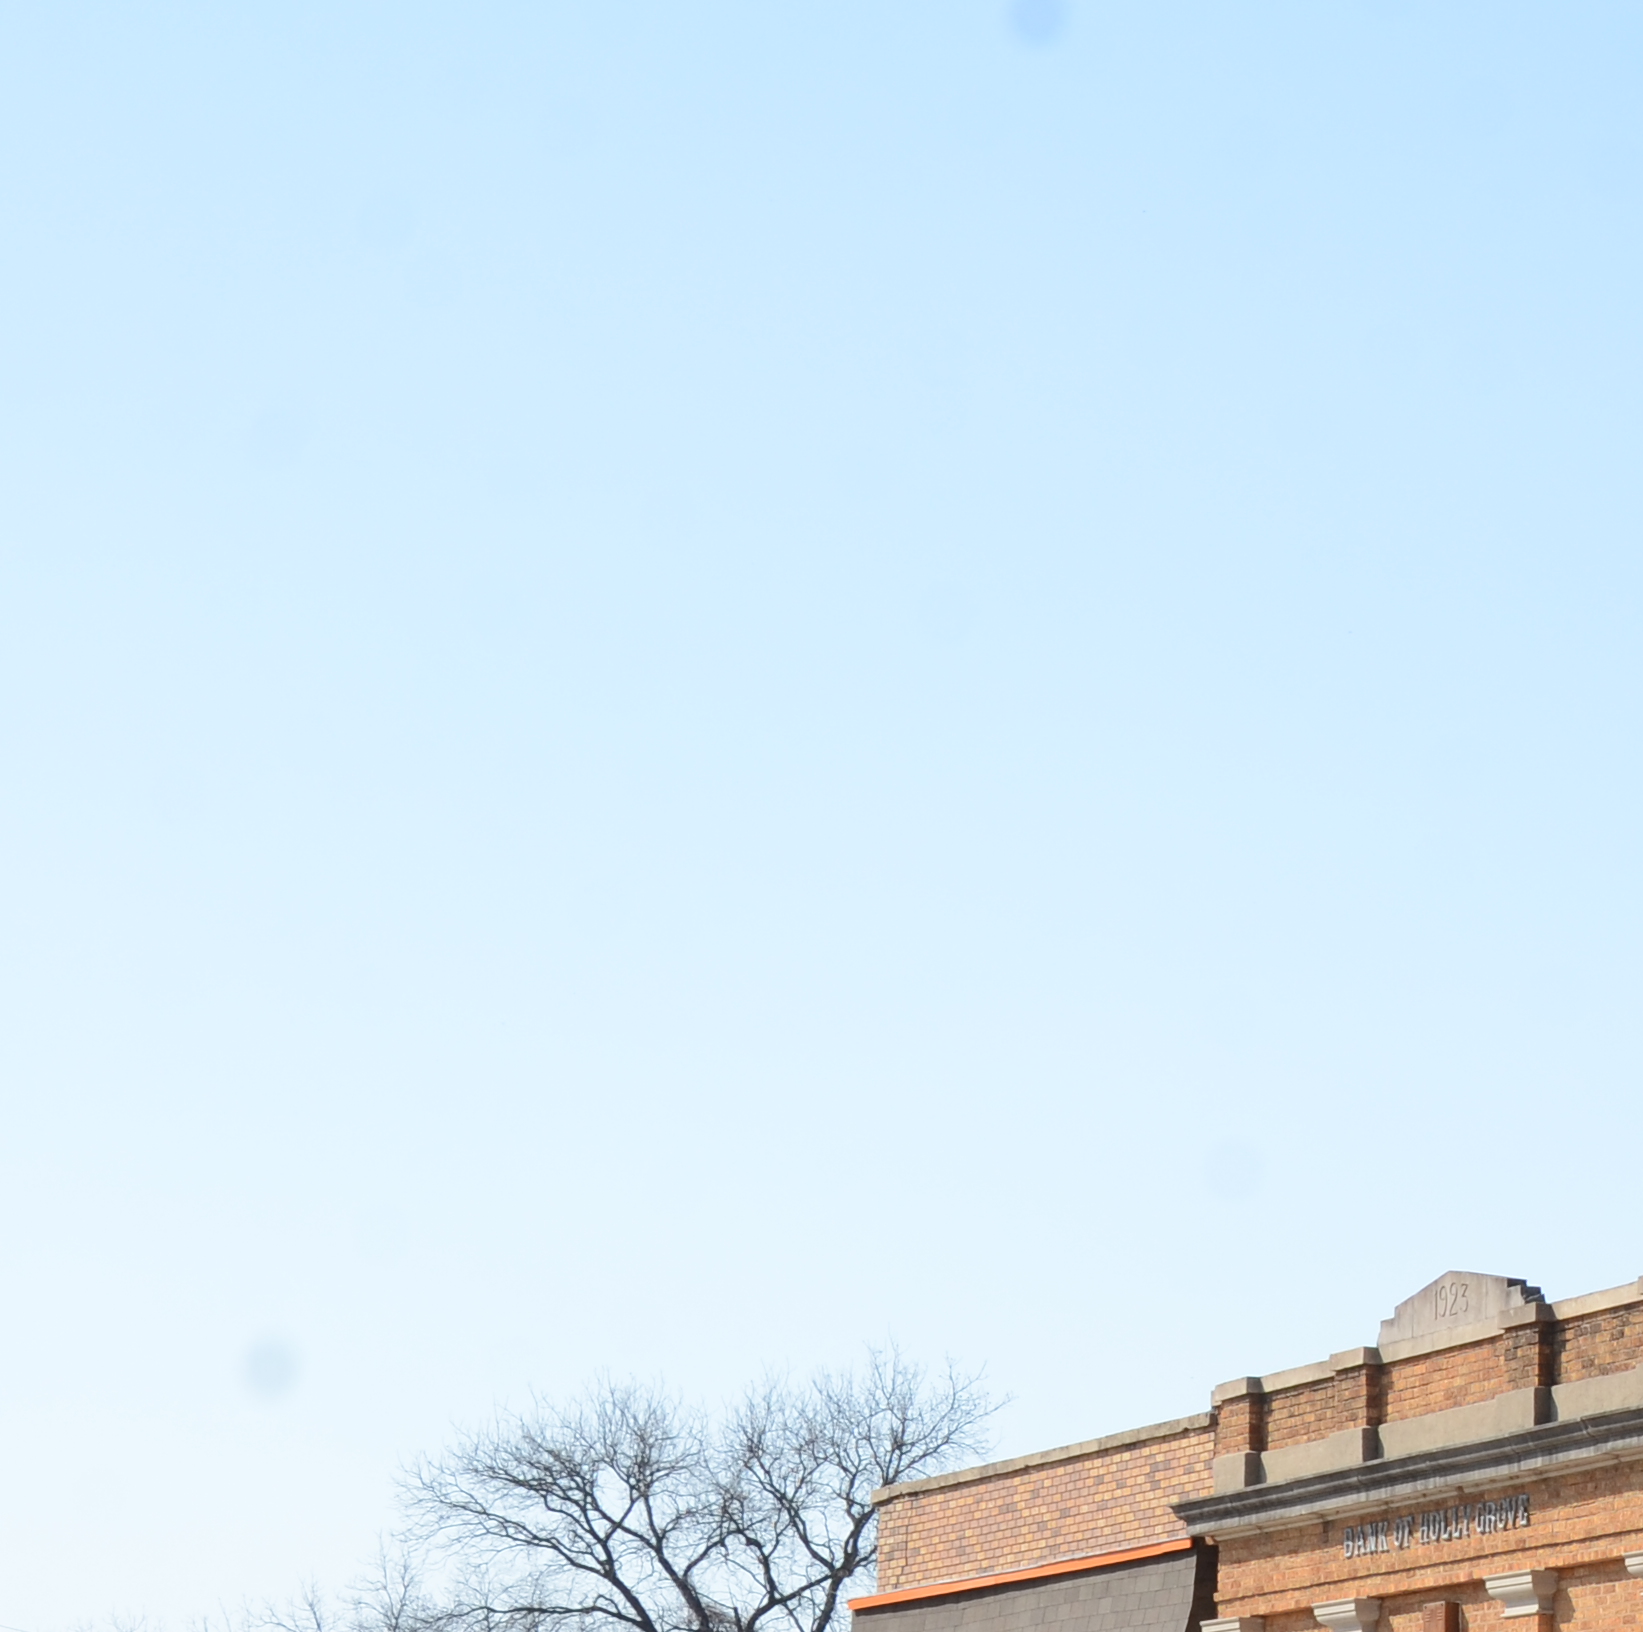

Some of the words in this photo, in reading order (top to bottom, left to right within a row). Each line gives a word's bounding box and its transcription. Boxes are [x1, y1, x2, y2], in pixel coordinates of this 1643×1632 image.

[1343, 1520, 1390, 1559] BANK
[1394, 1514, 1415, 1550] OF
[1419, 1503, 1472, 1545] HOLLY
[1475, 1494, 1530, 1534] GROVE
